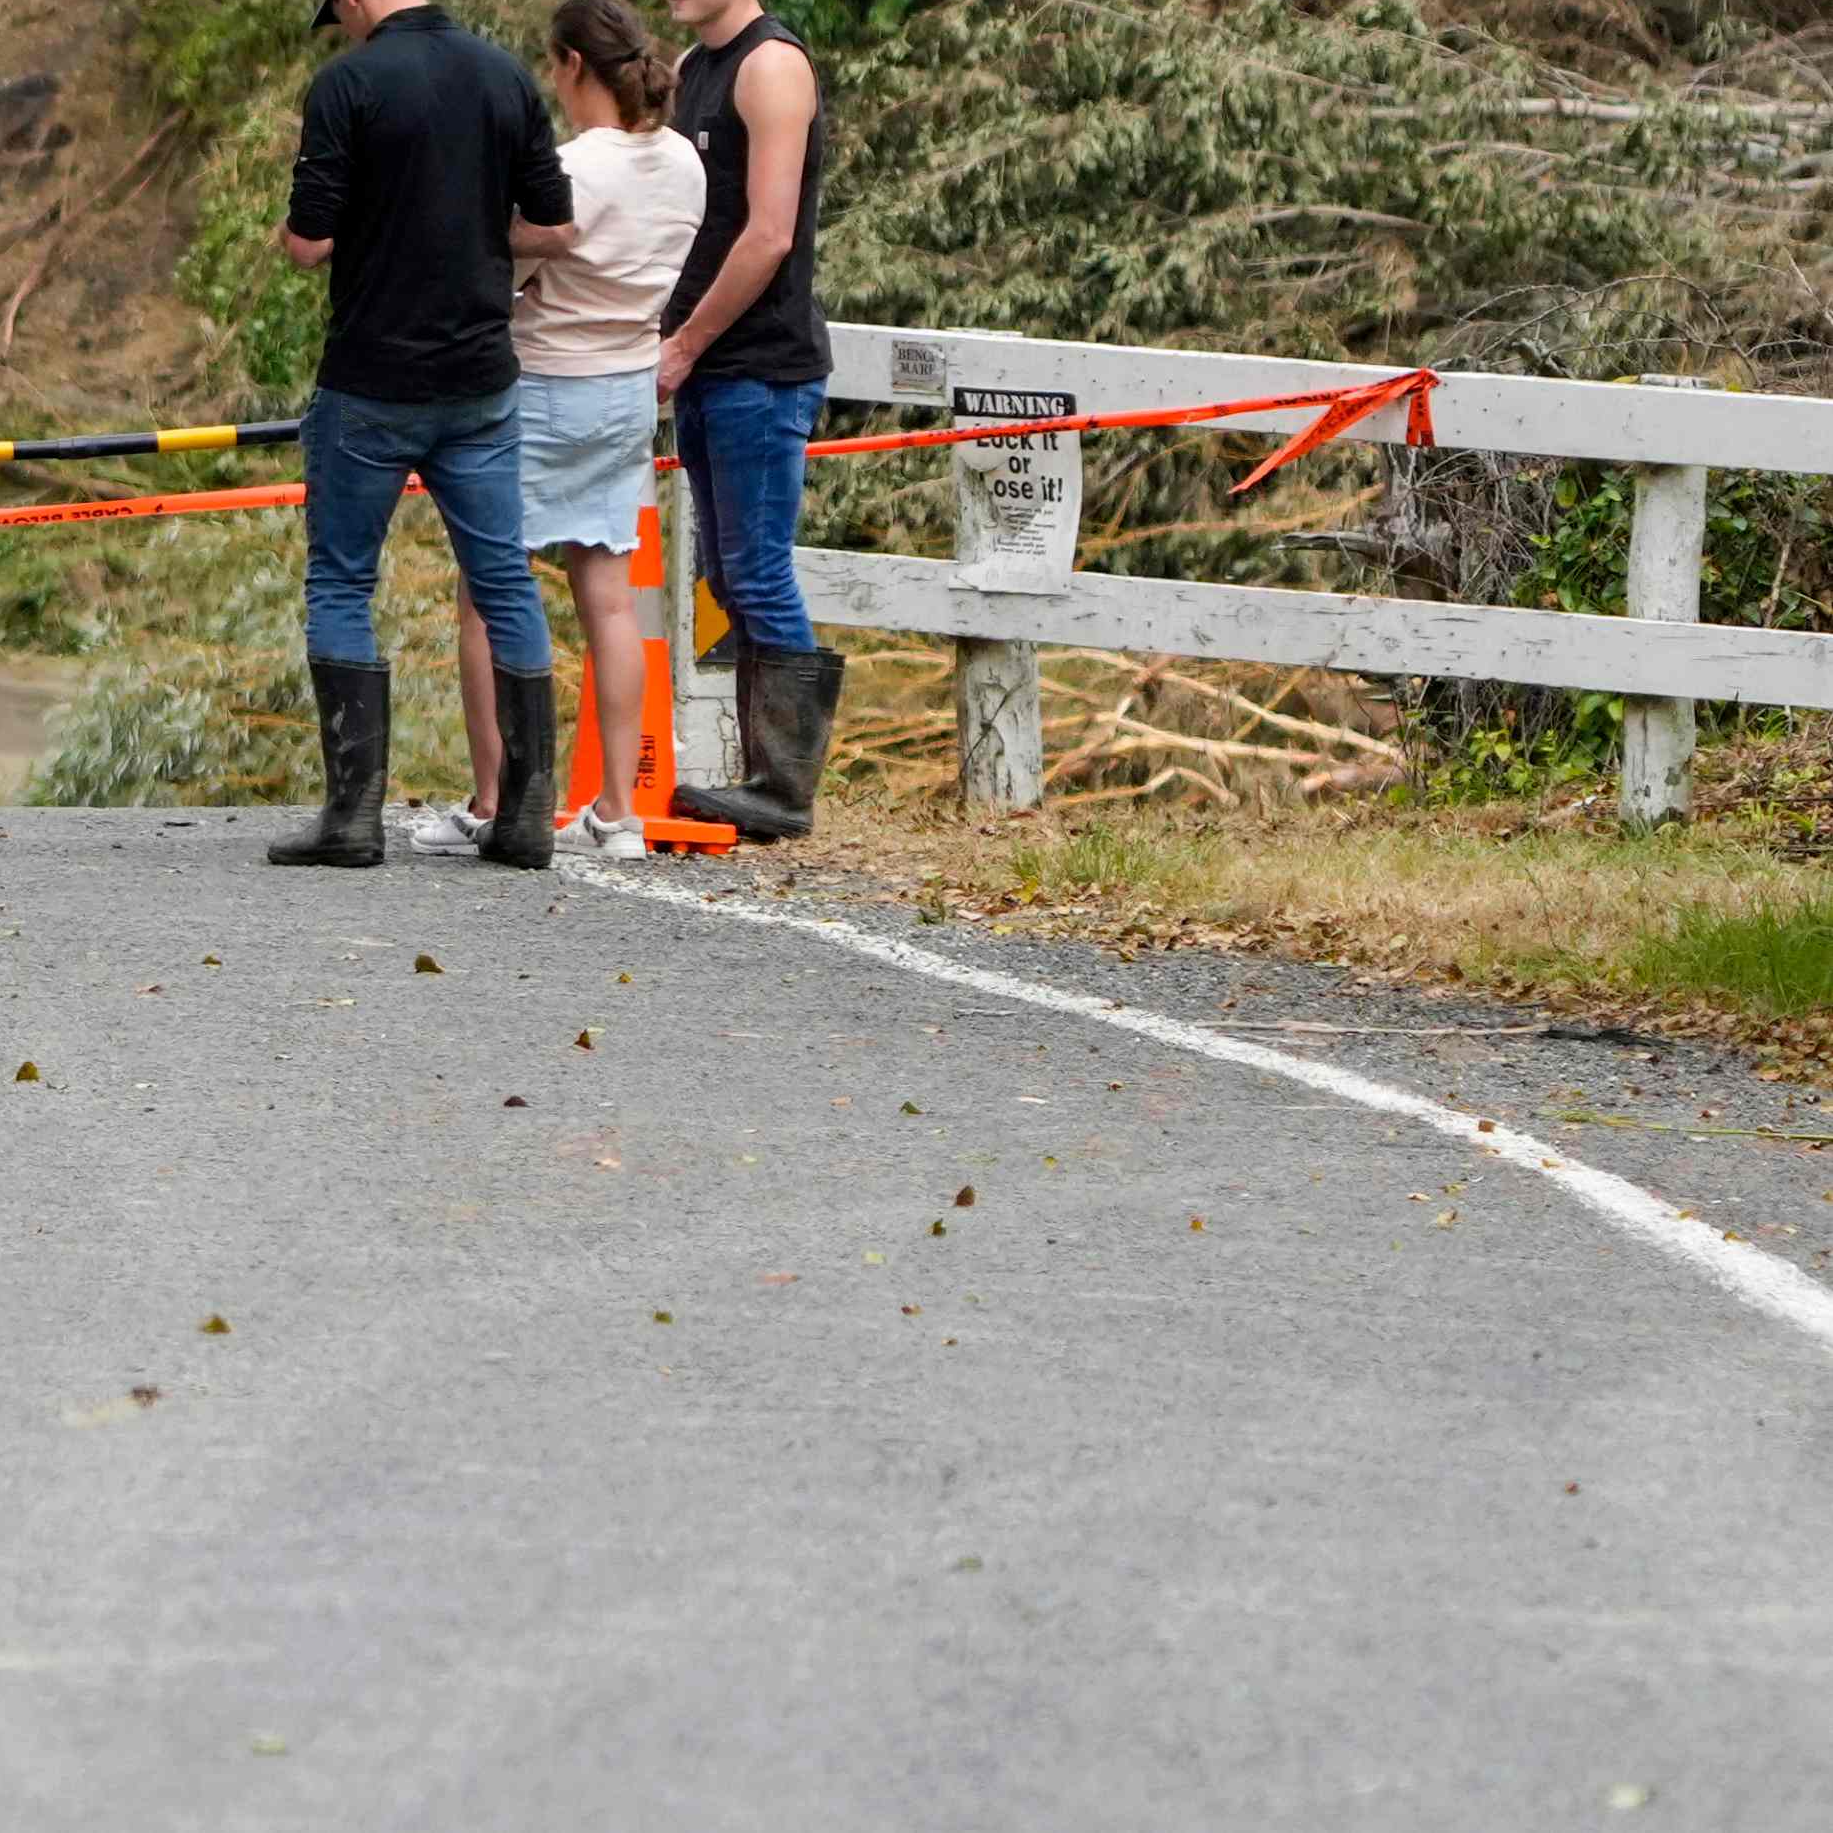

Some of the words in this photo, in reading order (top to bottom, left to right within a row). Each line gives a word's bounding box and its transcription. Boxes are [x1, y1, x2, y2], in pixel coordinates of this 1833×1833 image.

[898, 348, 937, 362] BENC
[962, 391, 1066, 416] WARNING
[1008, 456, 1031, 474] or
[989, 479, 1034, 500] ose
[1040, 475, 1063, 503] it!
